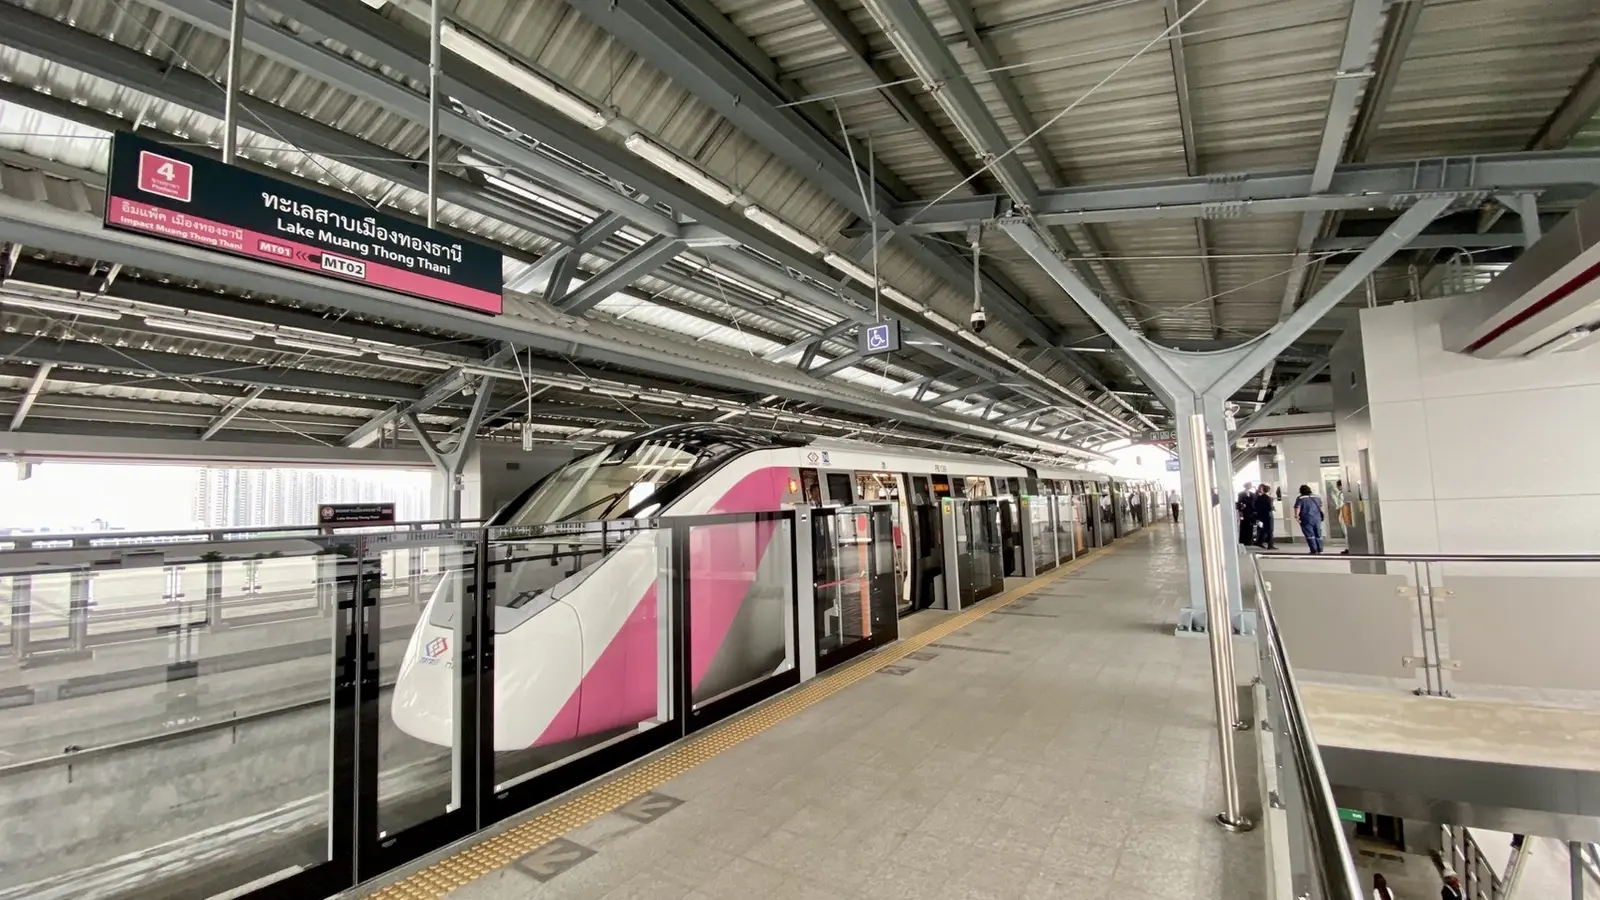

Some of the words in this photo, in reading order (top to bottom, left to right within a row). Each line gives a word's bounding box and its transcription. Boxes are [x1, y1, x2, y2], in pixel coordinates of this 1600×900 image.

[157, 162, 176, 182] 4
[120, 215, 156, 229] Impact
[156, 223, 188, 238] Muang
[190, 231, 217, 245] Thong
[219, 238, 243, 250] Thani
[171, 214, 243, 240] เมืองทองธานี
[261, 191, 462, 263] ทะเลสาบเมืองทองธานี
[259, 241, 292, 257] MT01
[277, 217, 315, 239] Lake
[318, 229, 369, 256] Muang
[372, 244, 414, 268] Thong
[417, 256, 451, 276] Thani
[324, 256, 363, 275] MT02
